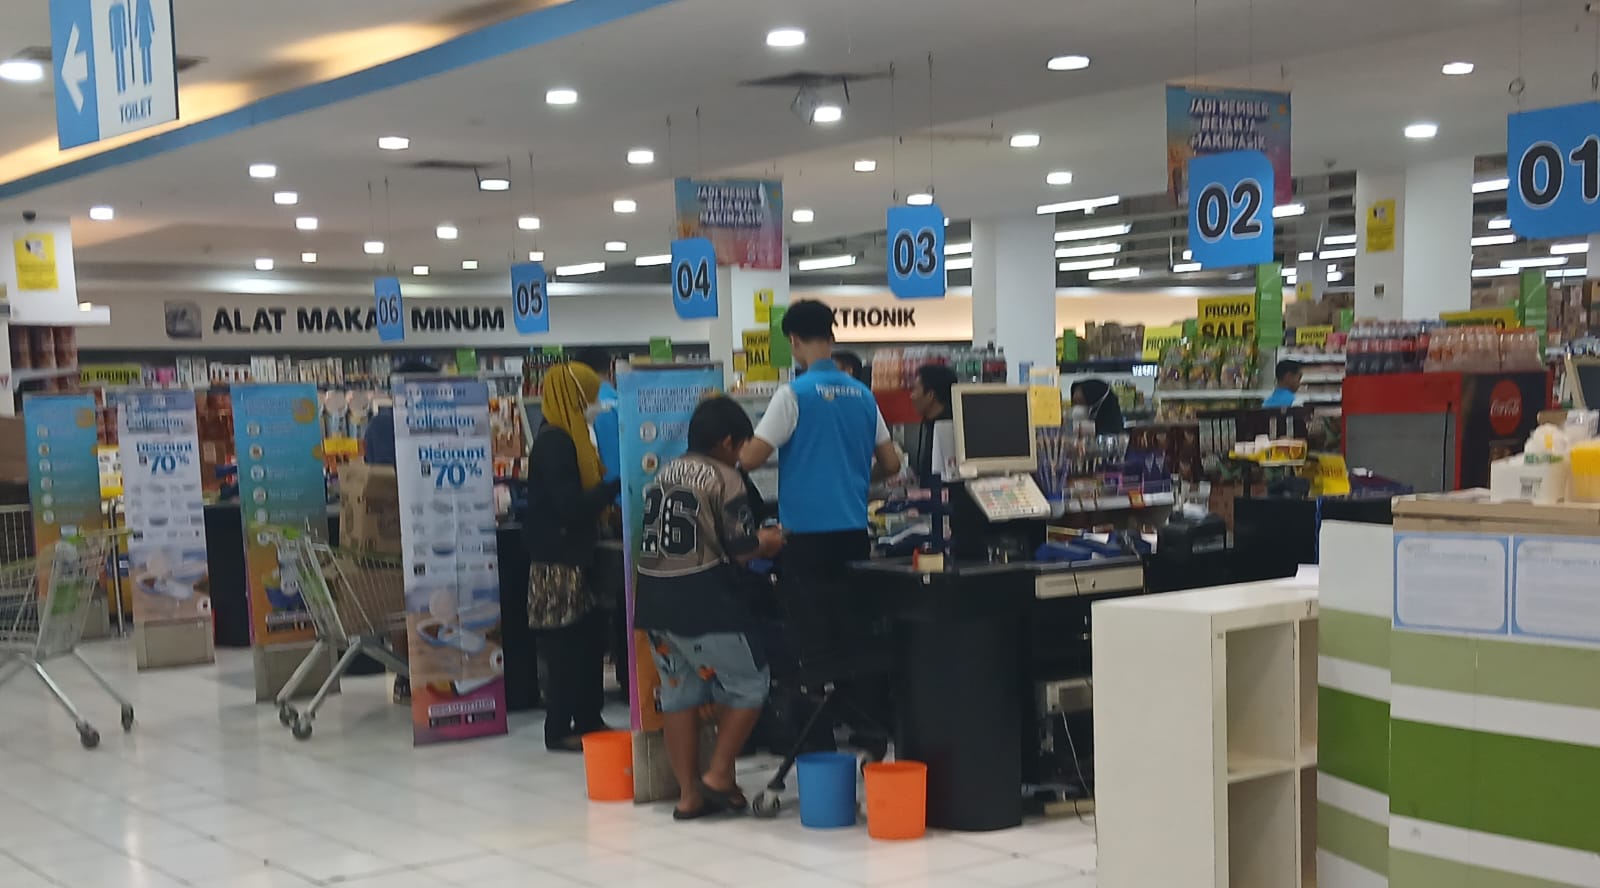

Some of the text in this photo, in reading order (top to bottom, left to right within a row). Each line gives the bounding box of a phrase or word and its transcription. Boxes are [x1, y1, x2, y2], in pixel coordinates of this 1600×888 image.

[120, 96, 152, 122] TOILET
[1518, 134, 1600, 210] 01
[1196, 178, 1263, 243] 02
[892, 228, 937, 278] 03
[676, 258, 711, 304] 04
[378, 296, 399, 325] 06
[516, 282, 543, 316] 05
[1205, 303, 1250, 319] PROMO
[212, 307, 287, 333] ALAT
[411, 307, 505, 331] MINUM
[747, 349, 770, 367] SAL
[405, 413, 475, 429] Collection
[418, 445, 484, 461] Discount
[431, 461, 482, 490] 70%
